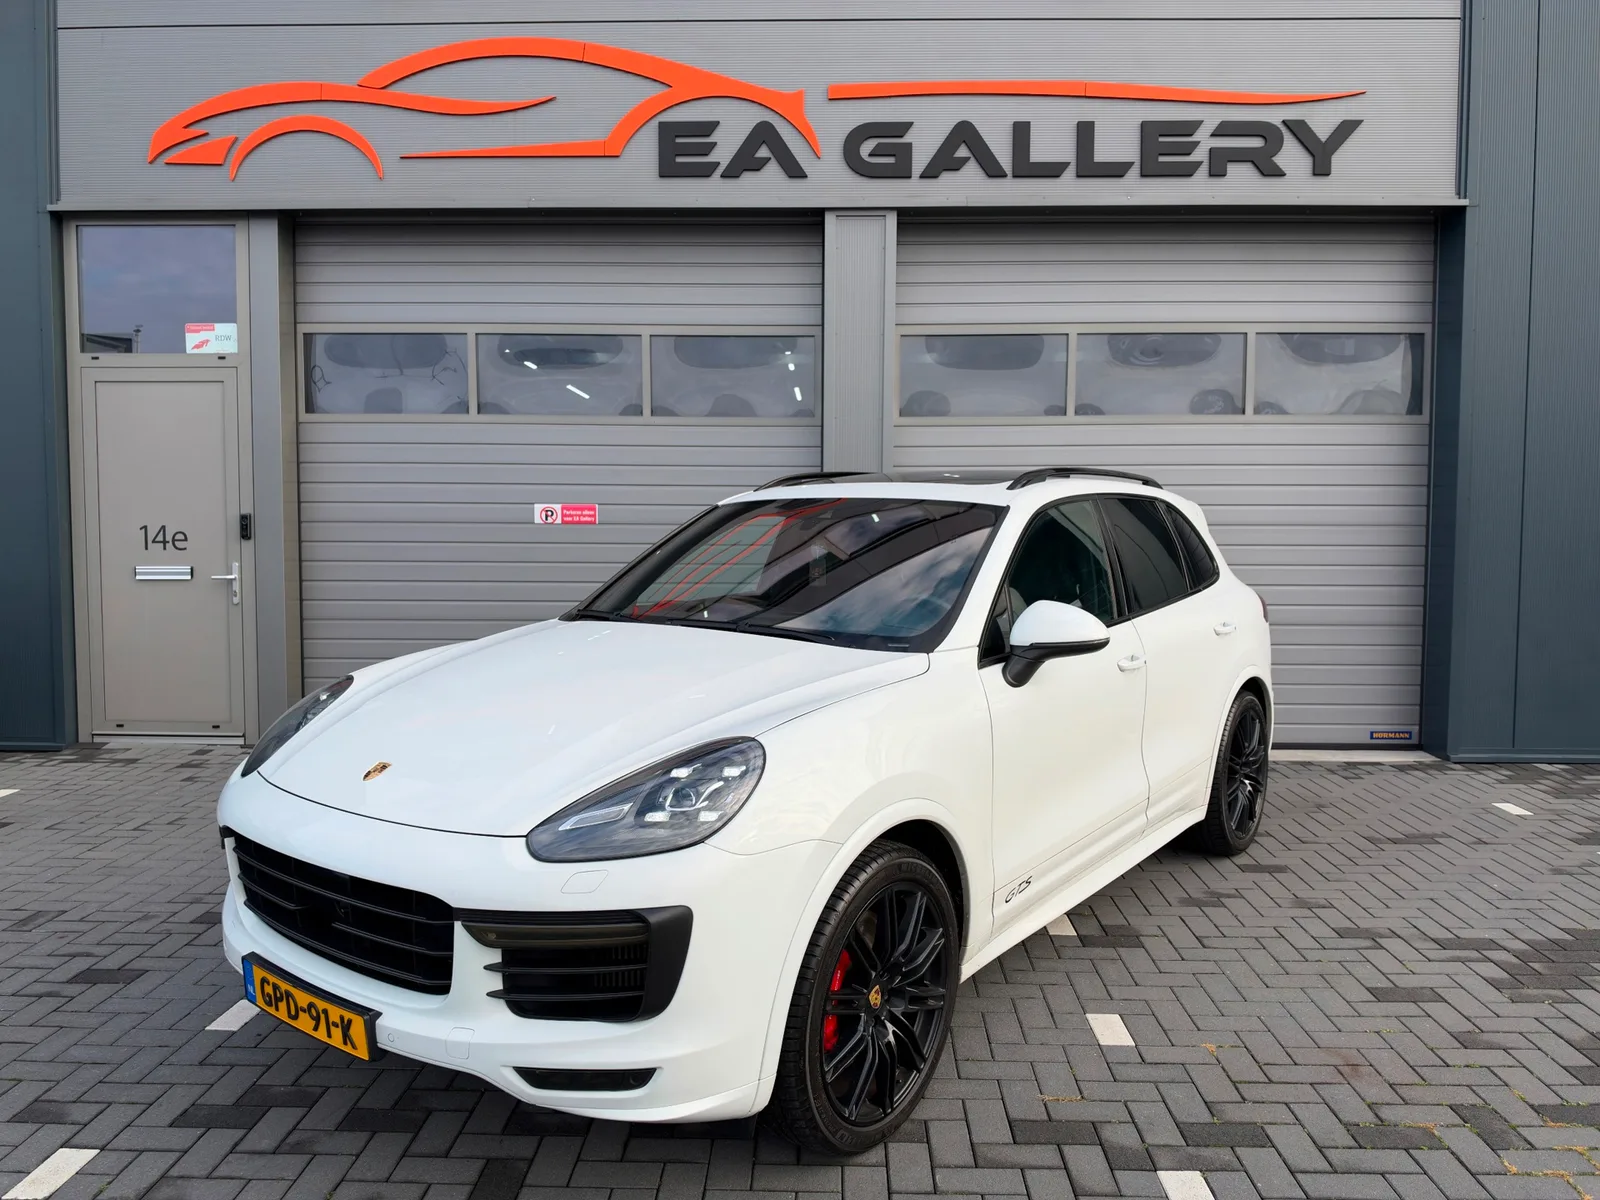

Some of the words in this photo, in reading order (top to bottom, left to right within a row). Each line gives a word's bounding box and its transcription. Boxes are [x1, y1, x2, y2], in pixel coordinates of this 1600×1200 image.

[658, 120, 808, 178] EA
[843, 119, 1364, 178] GALLERY
[215, 334, 232, 342] RDW
[139, 524, 189, 551] 14e
[1004, 875, 1033, 904] GTS
[247, 983, 256, 995] NL
[260, 975, 358, 1051] GPD-91-K
